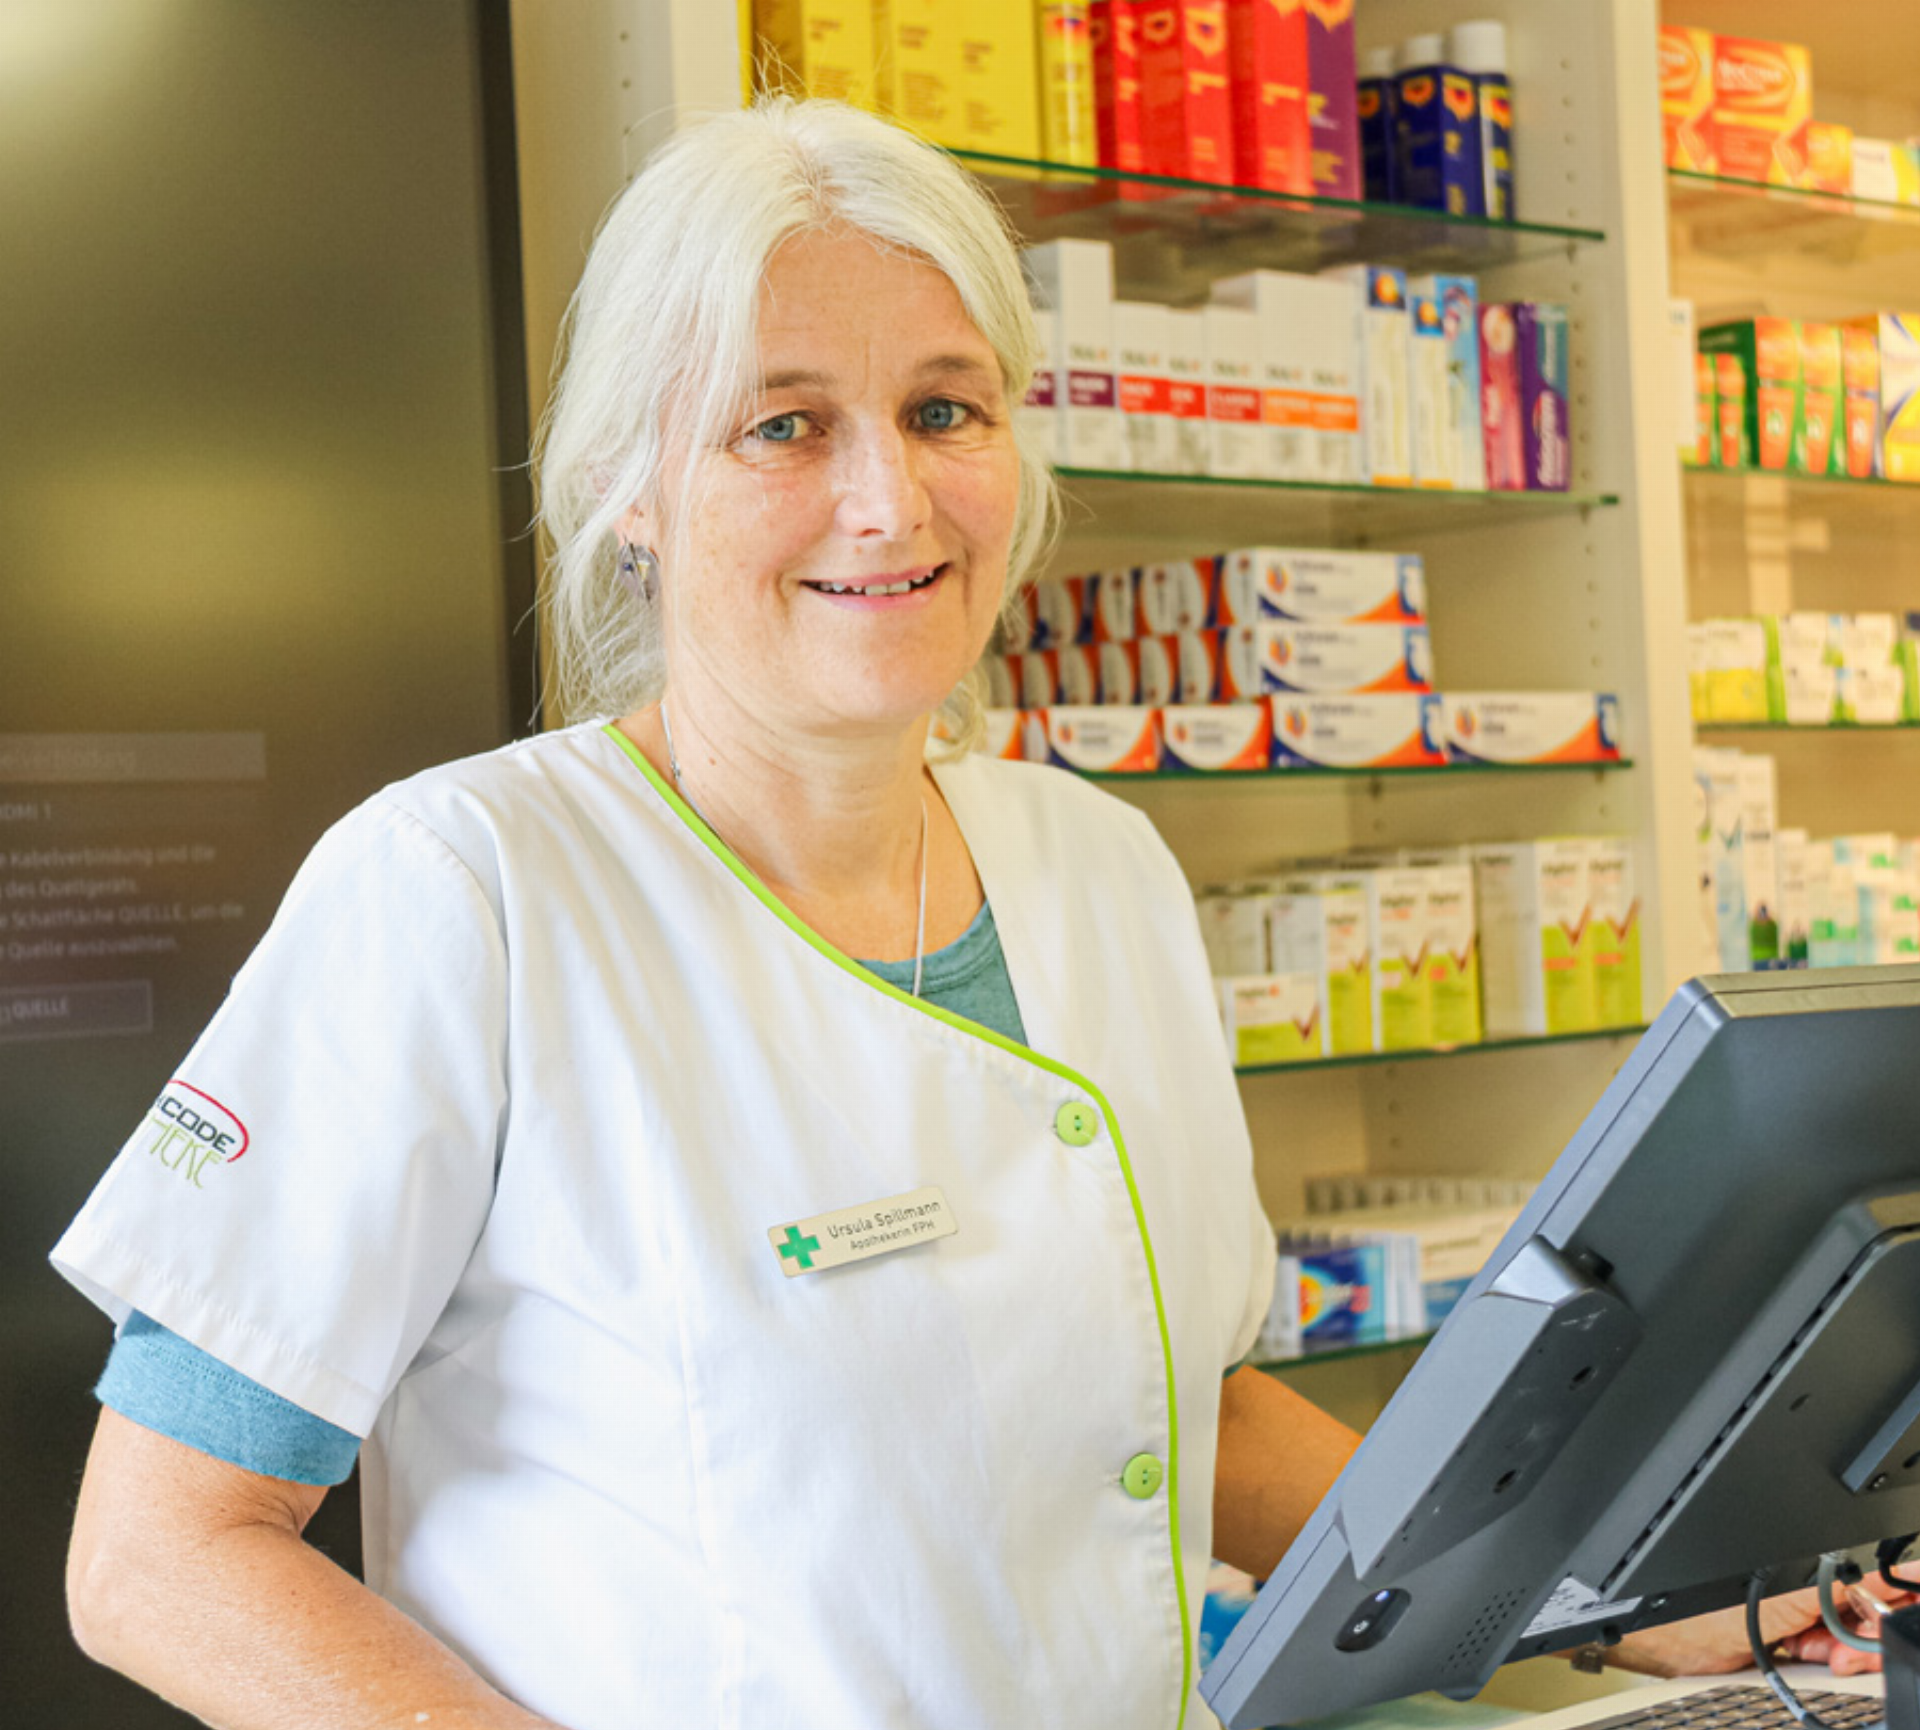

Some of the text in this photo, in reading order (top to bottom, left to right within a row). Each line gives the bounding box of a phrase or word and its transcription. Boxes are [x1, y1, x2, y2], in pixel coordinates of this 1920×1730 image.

[827, 1201, 941, 1240] Ursula Spillmann
[850, 1219, 935, 1250] Apothekerin FPH
